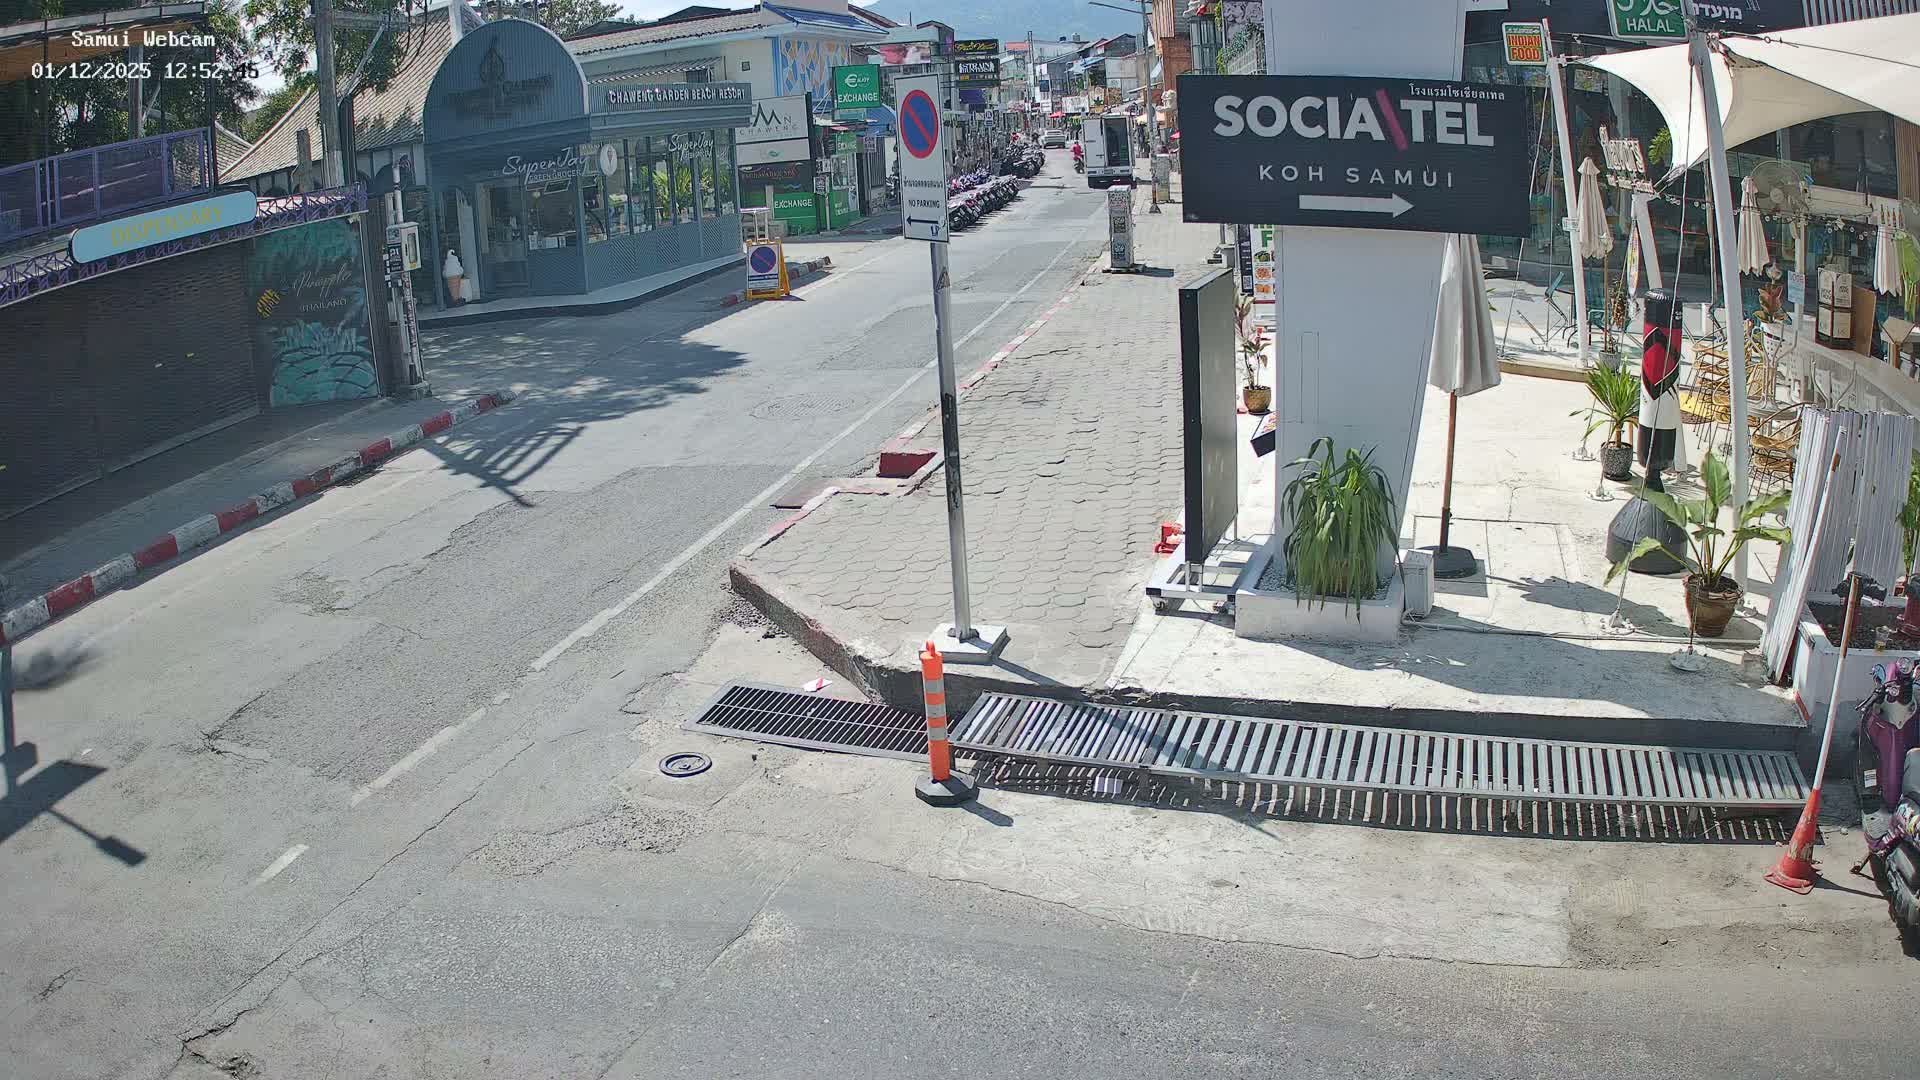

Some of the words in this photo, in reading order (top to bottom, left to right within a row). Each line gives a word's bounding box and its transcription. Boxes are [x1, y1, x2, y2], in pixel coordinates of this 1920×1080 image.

[1626, 18, 1675, 32] HALAL
[1507, 34, 1541, 47] INDIAN
[1511, 47, 1541, 60] FOOD
[609, 89, 653, 104] CHAWENG
[656, 88, 689, 102] GARDEN
[692, 87, 716, 99] BEACH
[719, 87, 745, 99] RESORT
[838, 92, 878, 103] EXCHANGE
[1259, 164, 1323, 182] KOH
[1345, 166, 1452, 188] SAMUI
[774, 199, 813, 209] EXCHANGE
[908, 199, 916, 207] NO
[917, 199, 940, 209] PARKING
